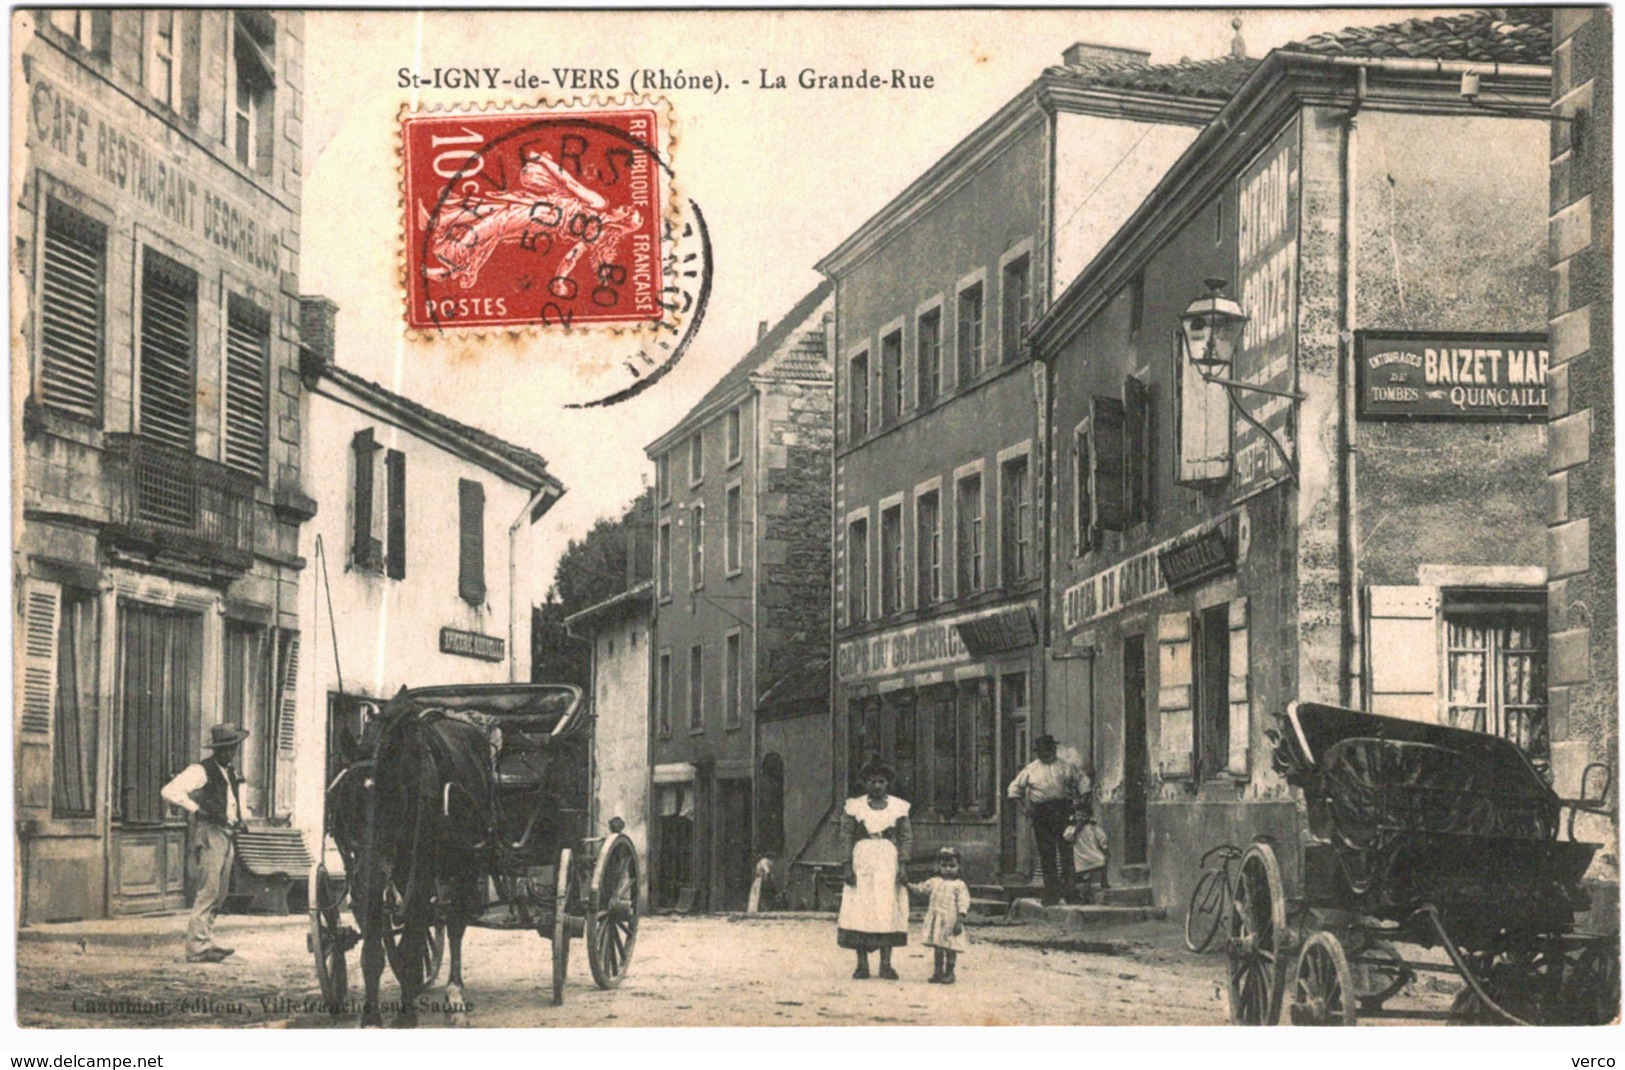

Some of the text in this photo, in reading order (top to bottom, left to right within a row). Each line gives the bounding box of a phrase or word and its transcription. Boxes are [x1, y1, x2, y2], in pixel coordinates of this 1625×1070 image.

[398, 67, 620, 89] St-IGNY-de-VERS
[759, 68, 787, 89] La
[798, 68, 934, 89] Grande-Rue
[98, 119, 198, 231] RESTAURANT
[630, 119, 653, 312] REUBLIQUE FRANÇAISE
[425, 297, 507, 319] POSTES
[1424, 348, 1502, 384] BAIZET
[1371, 386, 1419, 401] TOMBES
